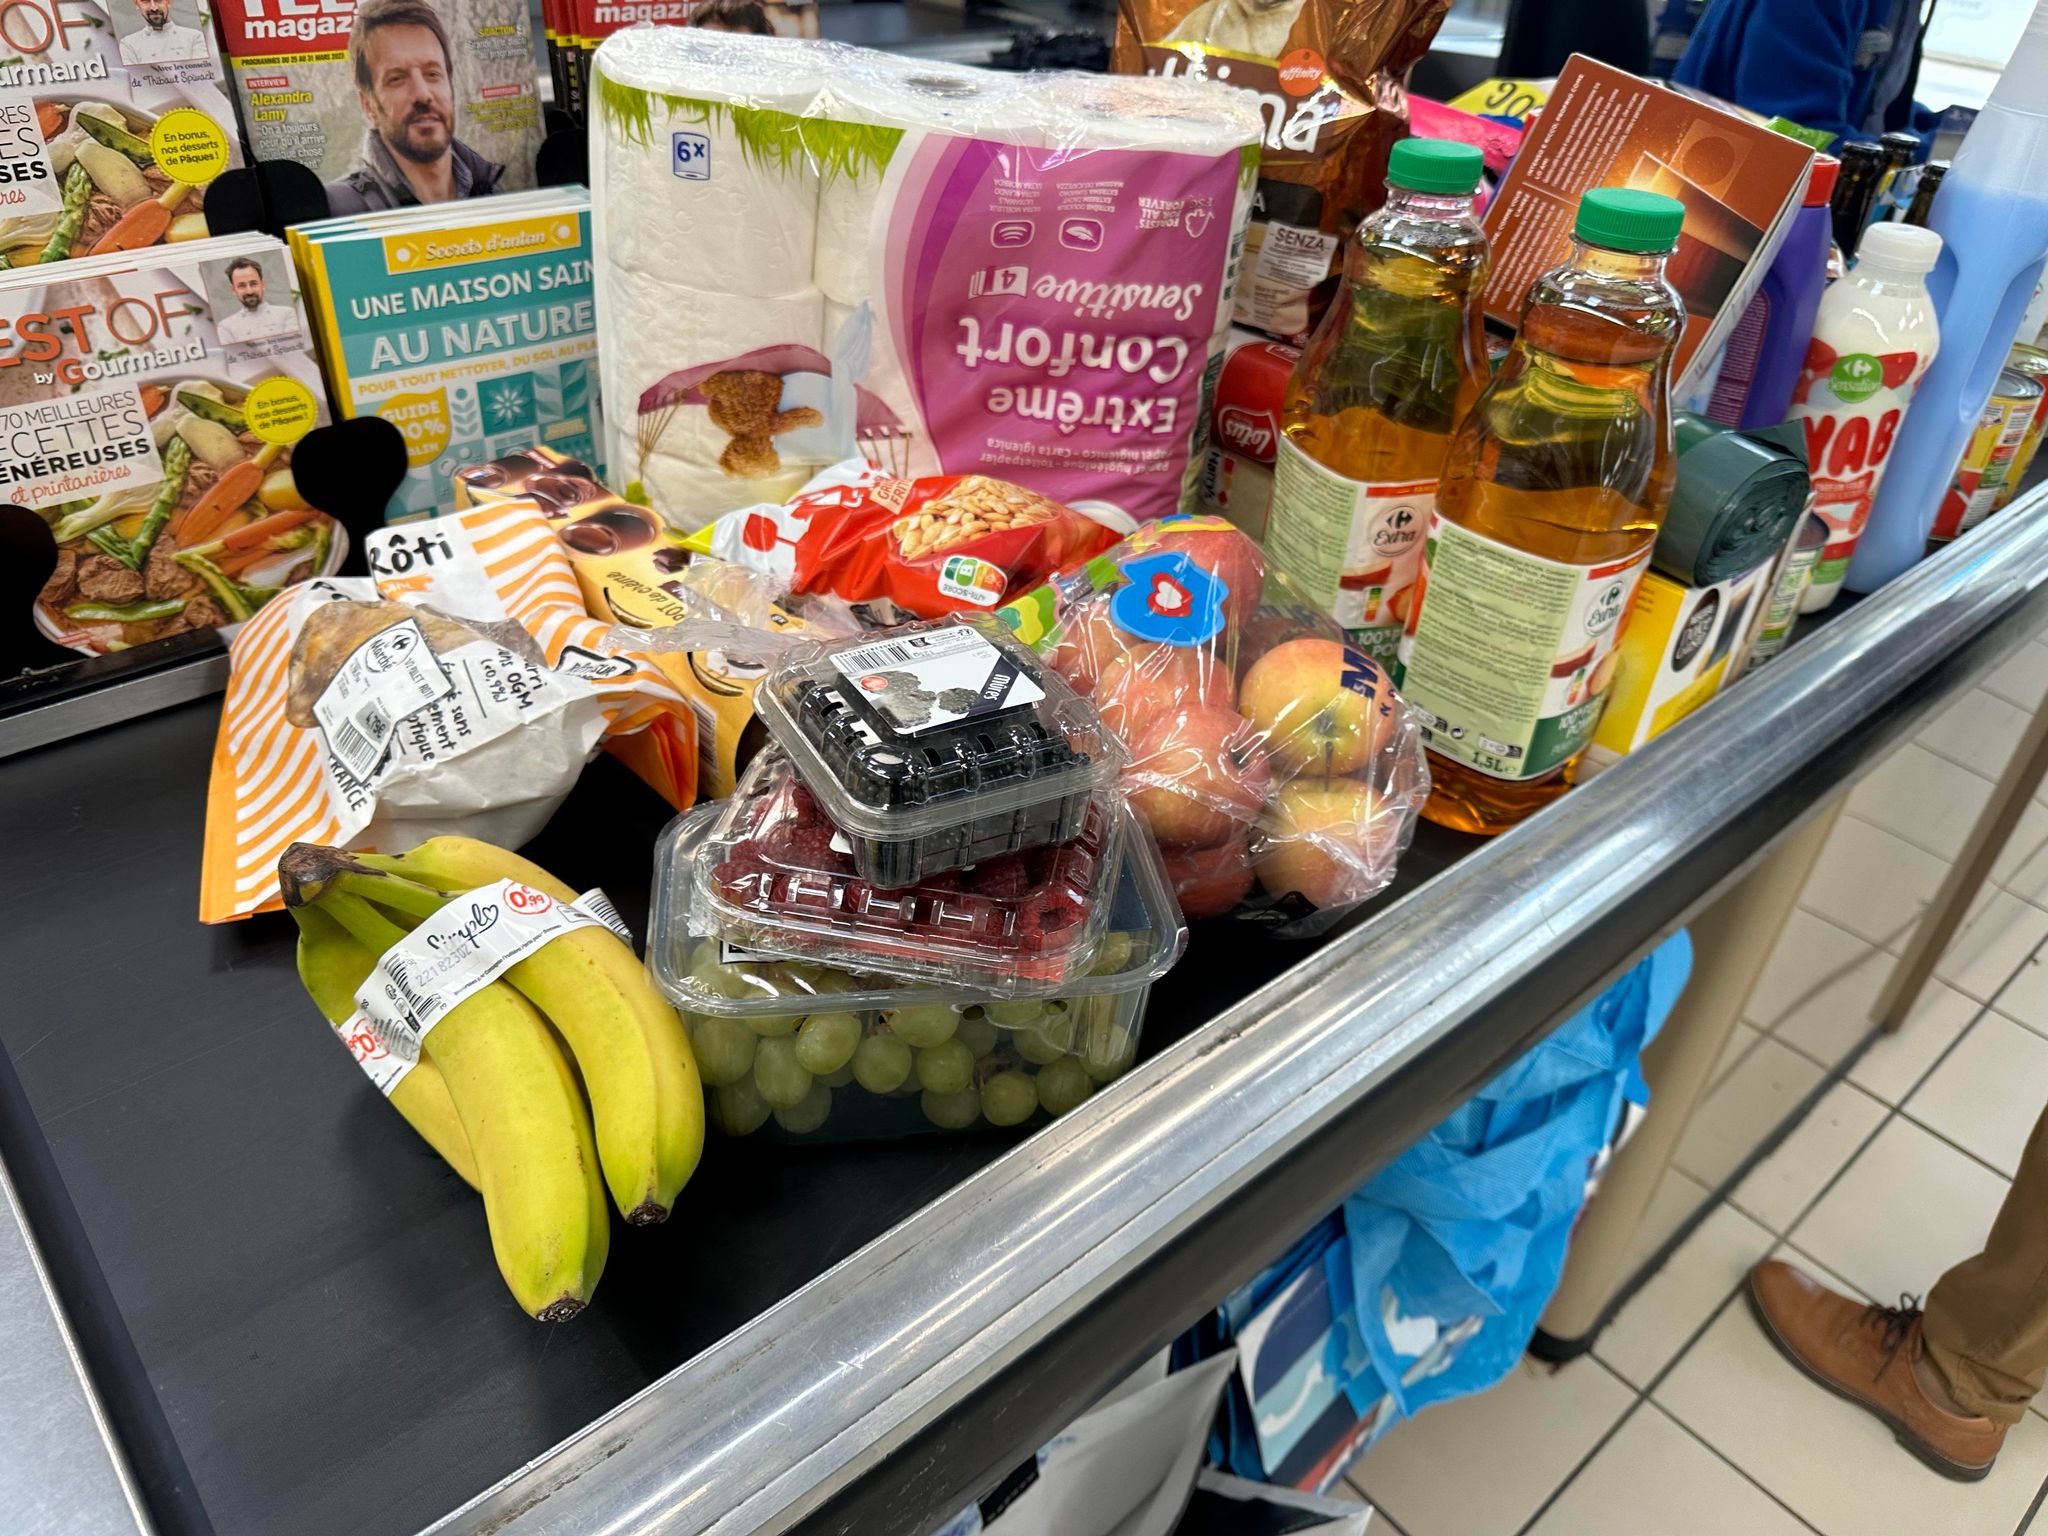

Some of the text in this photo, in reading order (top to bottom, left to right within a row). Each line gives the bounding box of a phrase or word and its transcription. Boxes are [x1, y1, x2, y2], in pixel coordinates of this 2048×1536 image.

[0, 0, 101, 53] OF
[245, 15, 355, 41] magaz
[241, 58, 279, 66] PROGRAMMES
[248, 77, 287, 88] INTERVIEW
[251, 91, 313, 107] Alexandra
[253, 107, 287, 123] Lamy
[161, 141, 219, 155] nos desserts
[163, 130, 210, 143] En bonus,
[166, 155, 178, 165] de
[180, 151, 214, 165] Pâques
[425, 230, 547, 263] Secrets d'antan
[1275, 227, 1326, 252] SENZA
[351, 292, 407, 321] UNE
[410, 268, 533, 312] MAISON
[1033, 273, 1202, 322] Sensitive
[106, 288, 193, 345] OF
[370, 300, 595, 371] AU NATURE
[957, 316, 1190, 385] Confort
[35, 338, 207, 386] by Gourmand
[357, 379, 398, 397] POUR
[400, 372, 438, 390] TOUT
[512, 354, 530, 368] DU
[531, 349, 556, 366] SOL
[25, 390, 136, 427] MEILLEURES
[382, 399, 441, 424] GUIDE
[987, 387, 1179, 435] Extrême
[1224, 418, 1271, 455] Lotus
[10, 463, 132, 505] et printanières
[368, 532, 454, 577] Rôti
[1374, 528, 1416, 547] Extra
[648, 589, 667, 603] de
[370, 637, 394, 673] Marché
[507, 672, 534, 711] OGM
[983, 673, 1012, 701] mûres
[425, 701, 457, 752] ement
[451, 704, 472, 737] sans
[1470, 750, 1504, 773] 1,5L
